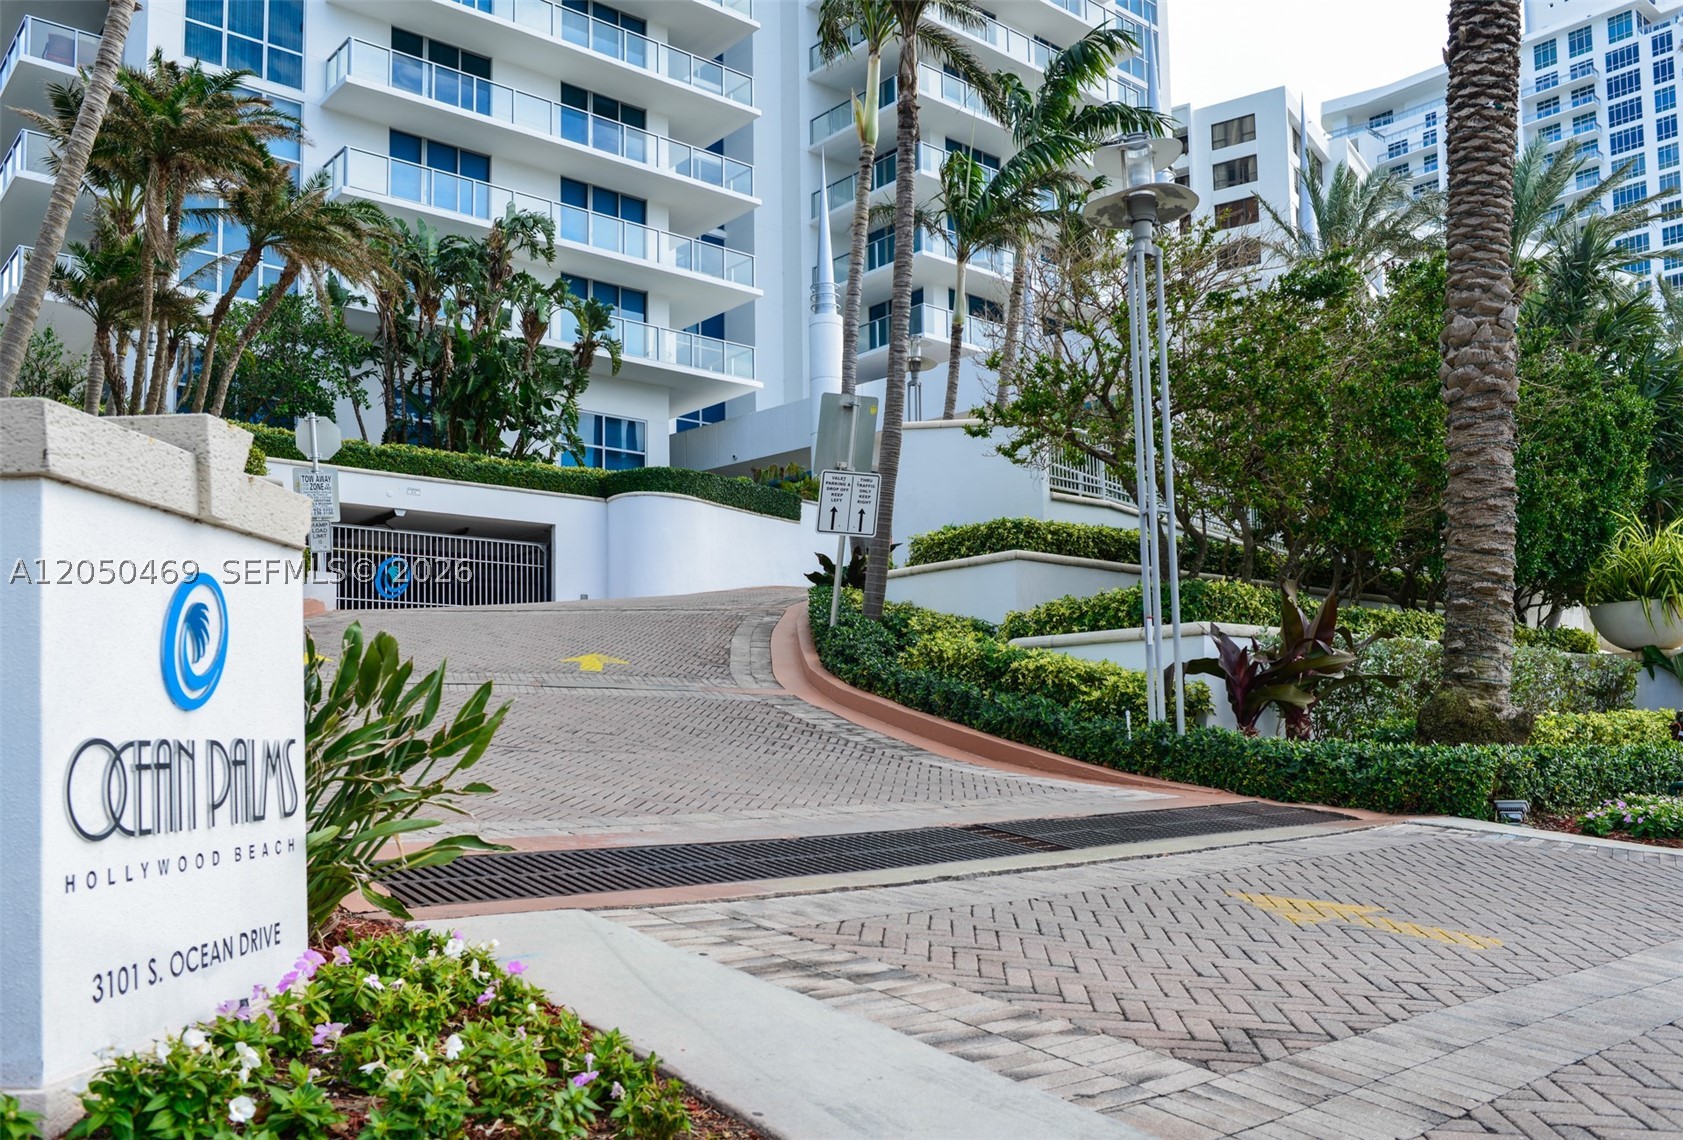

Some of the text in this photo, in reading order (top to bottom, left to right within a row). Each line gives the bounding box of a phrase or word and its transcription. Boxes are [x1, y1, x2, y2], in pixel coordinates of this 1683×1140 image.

[301, 475, 332, 483] TOW AWAY
[309, 483, 324, 491] ZONE
[64, 737, 298, 842] OCEAN PALMS
[65, 838, 295, 894] HOLLYWOOD BEACH
[91, 922, 281, 1004] 3101 S. OCEAN DRIVE
